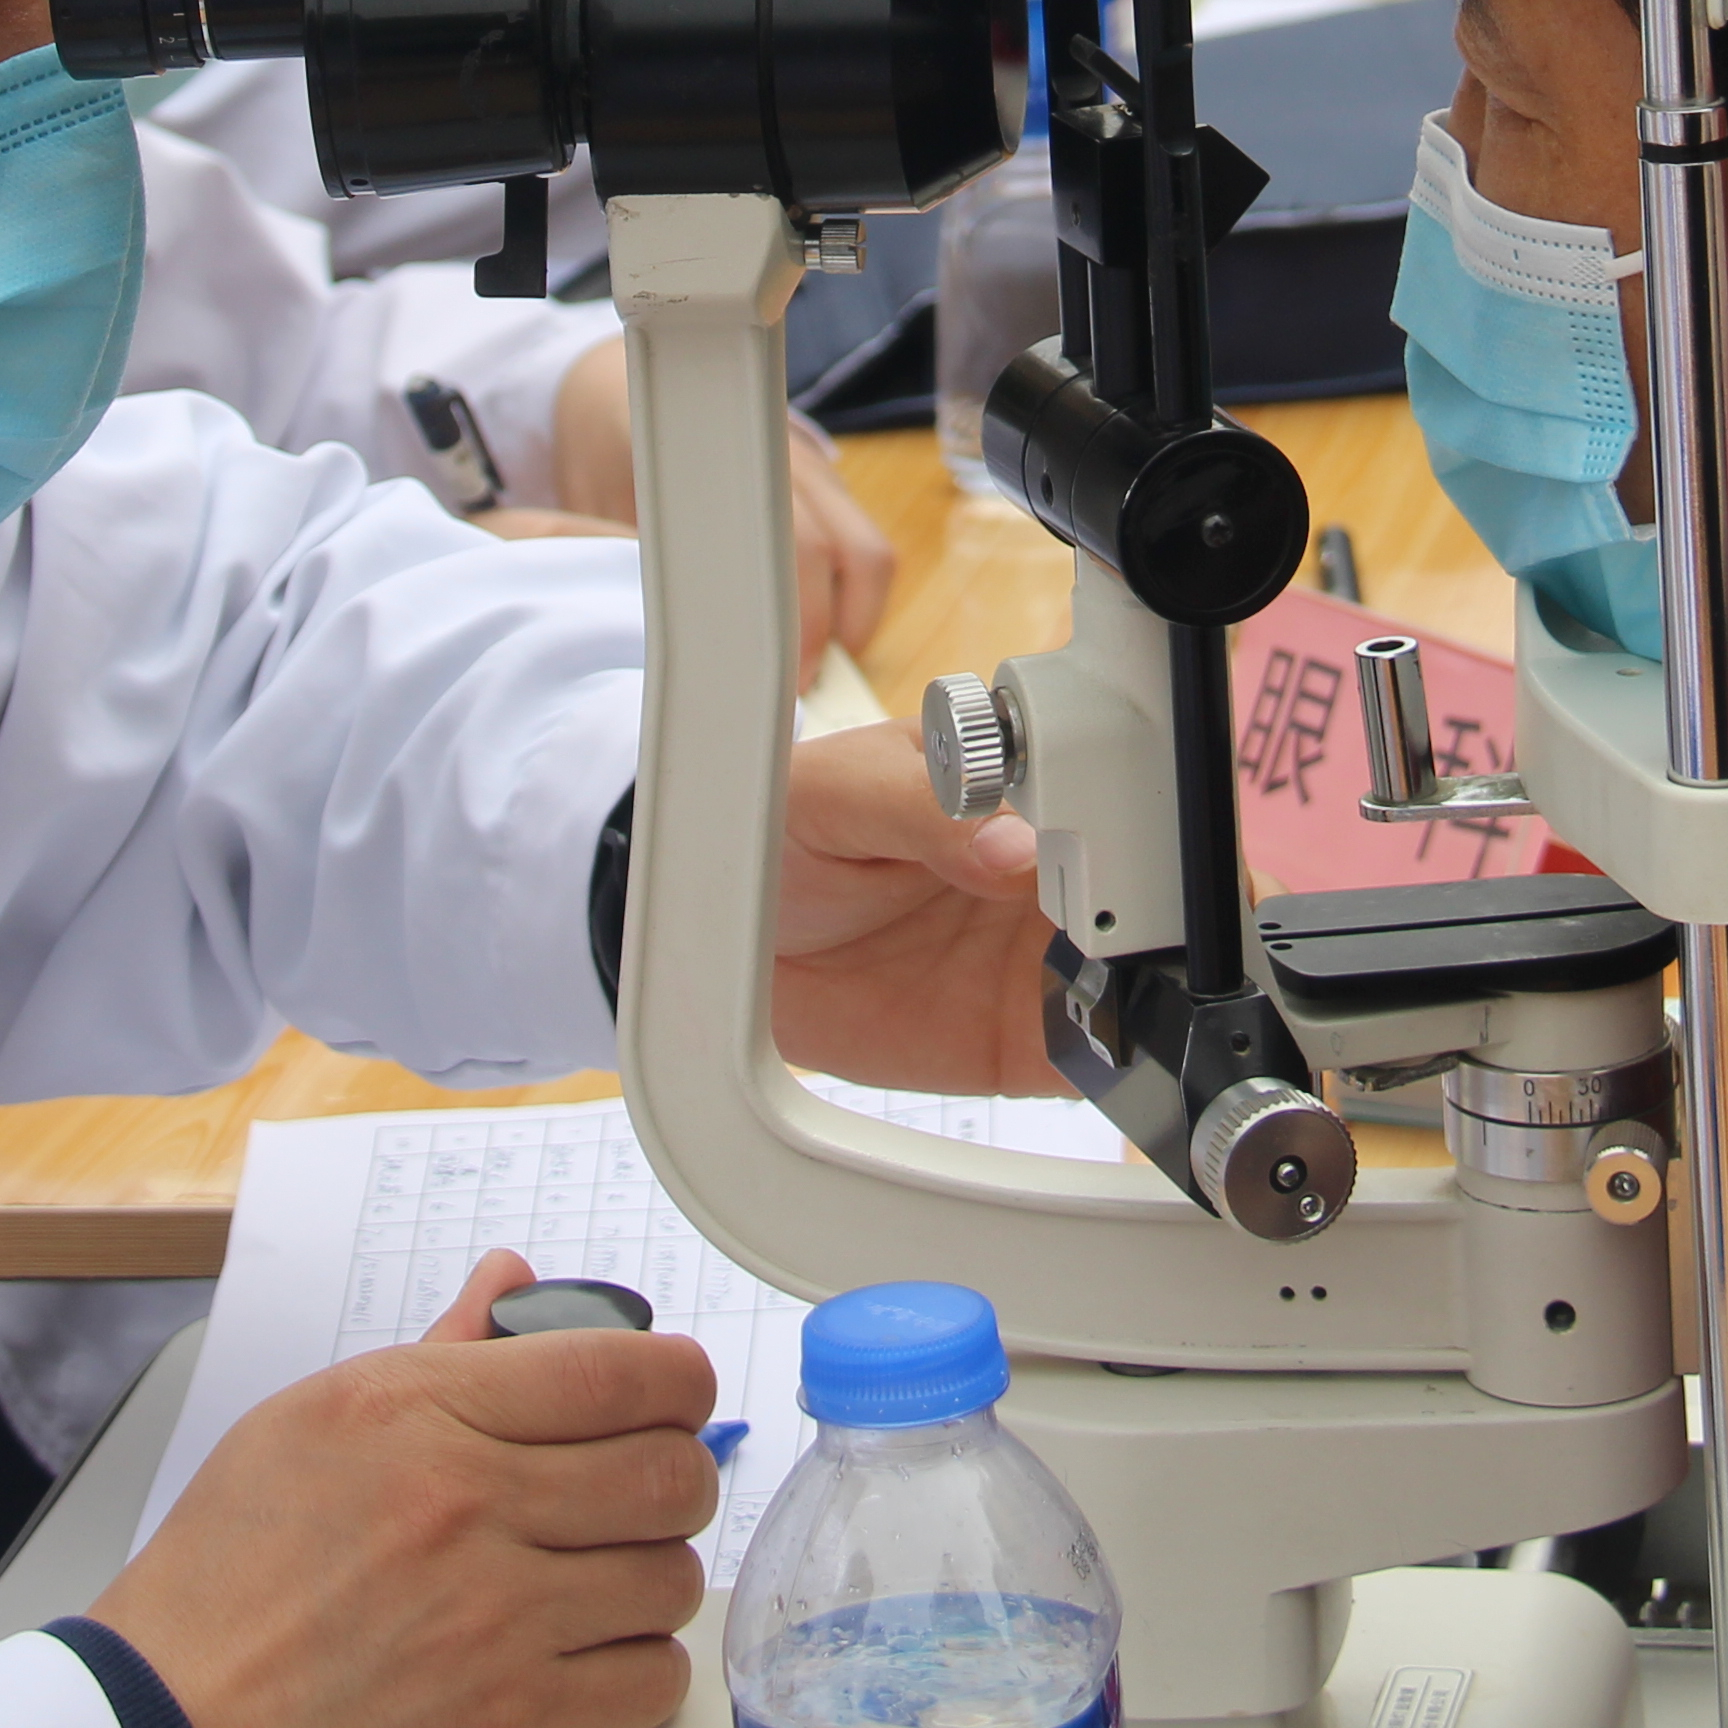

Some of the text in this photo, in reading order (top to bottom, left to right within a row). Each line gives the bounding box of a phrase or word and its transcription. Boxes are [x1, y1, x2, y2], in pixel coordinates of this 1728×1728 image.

[158, 36, 175, 44] 2
[1523, 1076, 1603, 1097] 0 30
